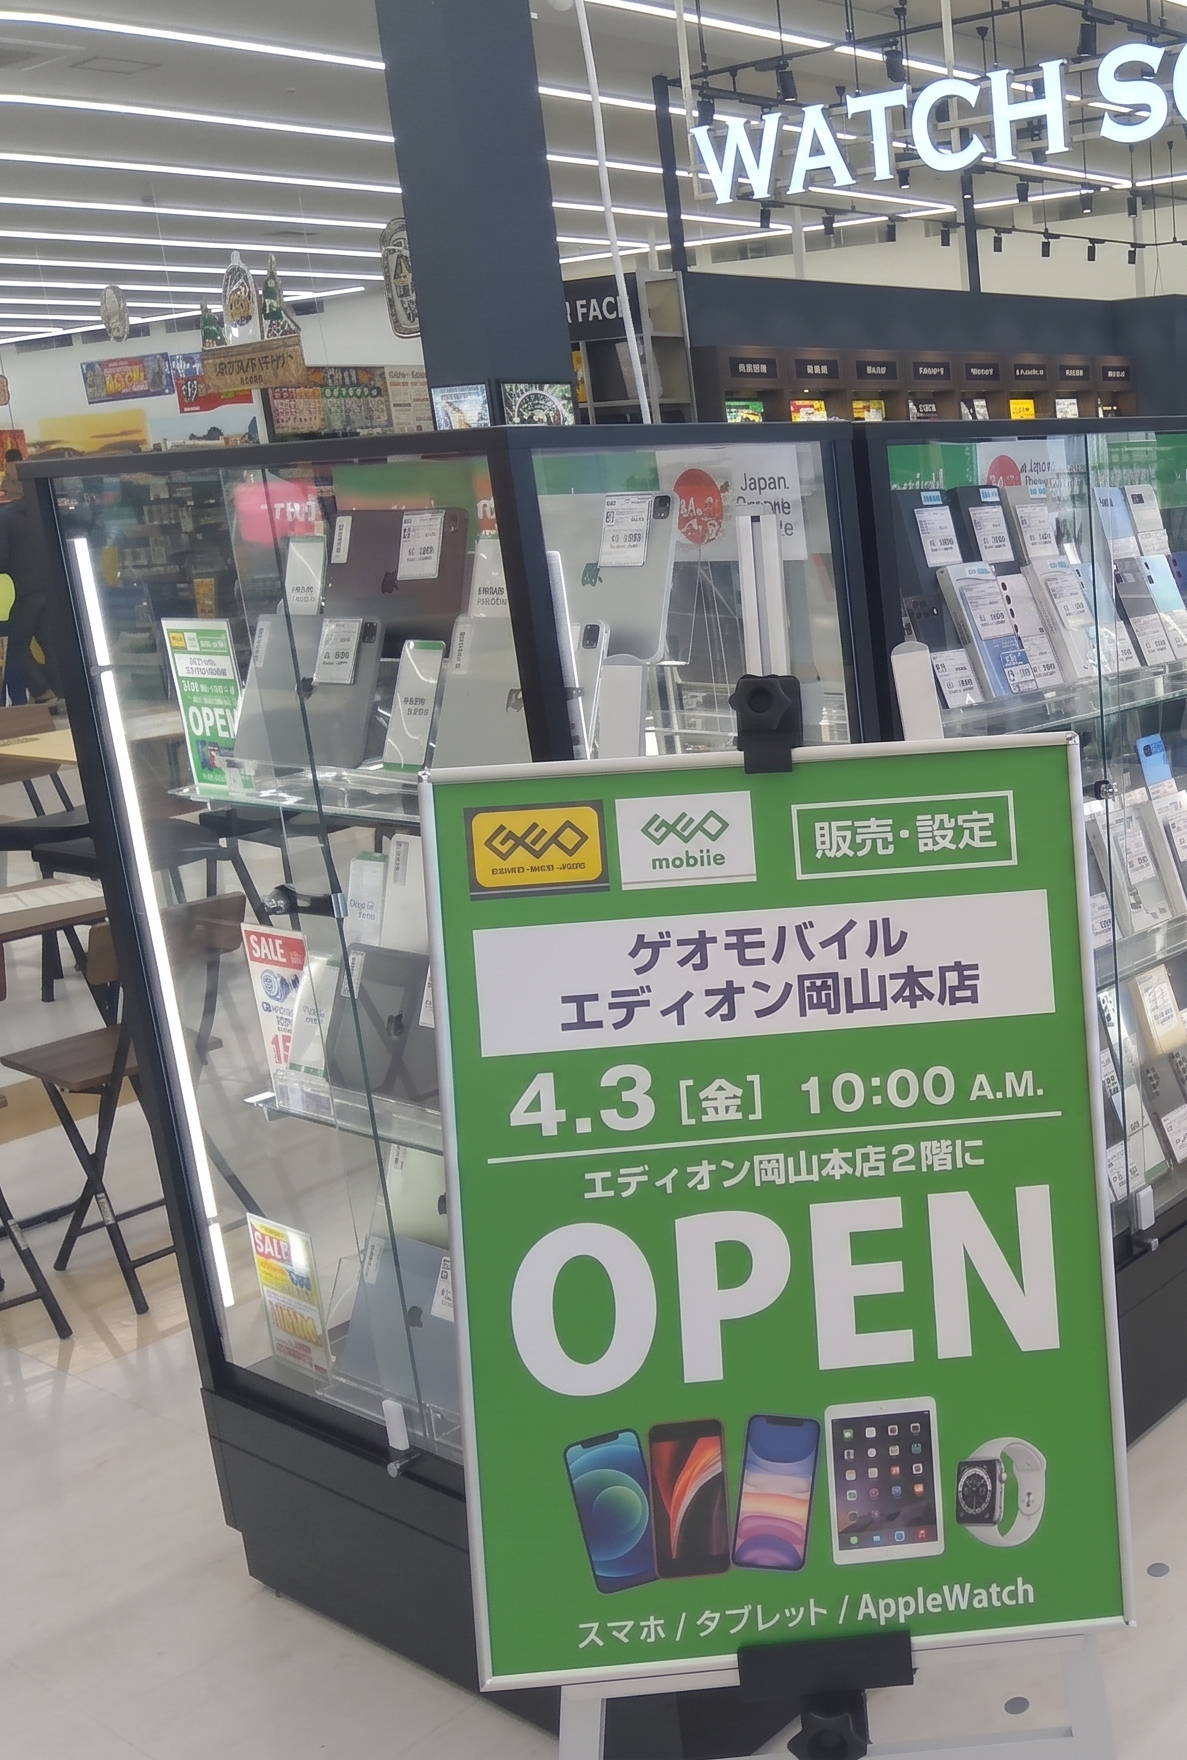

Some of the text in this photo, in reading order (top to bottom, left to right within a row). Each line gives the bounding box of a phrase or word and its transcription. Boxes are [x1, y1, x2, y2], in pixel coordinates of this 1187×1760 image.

[690, 59, 1072, 204] WATCH
[484, 819, 589, 862] GEO
[640, 809, 730, 846] GEO
[814, 811, 999, 860] 販売・設定
[250, 934, 287, 963] SALE
[628, 916, 908, 975] ゲオモバイル
[560, 960, 981, 1032] エディオン岡山本店
[509, 1064, 656, 1138] 4.3
[801, 1065, 956, 1114] 10:00
[968, 1070, 1044, 1102] A.M.
[583, 1140, 985, 1200] エディオン岡山本店2階に
[511, 1184, 1061, 1397] OPEN
[577, 1612, 668, 1649] スマホ
[696, 1598, 828, 1639] タブレット
[857, 1577, 1036, 1625] AppleWatch
